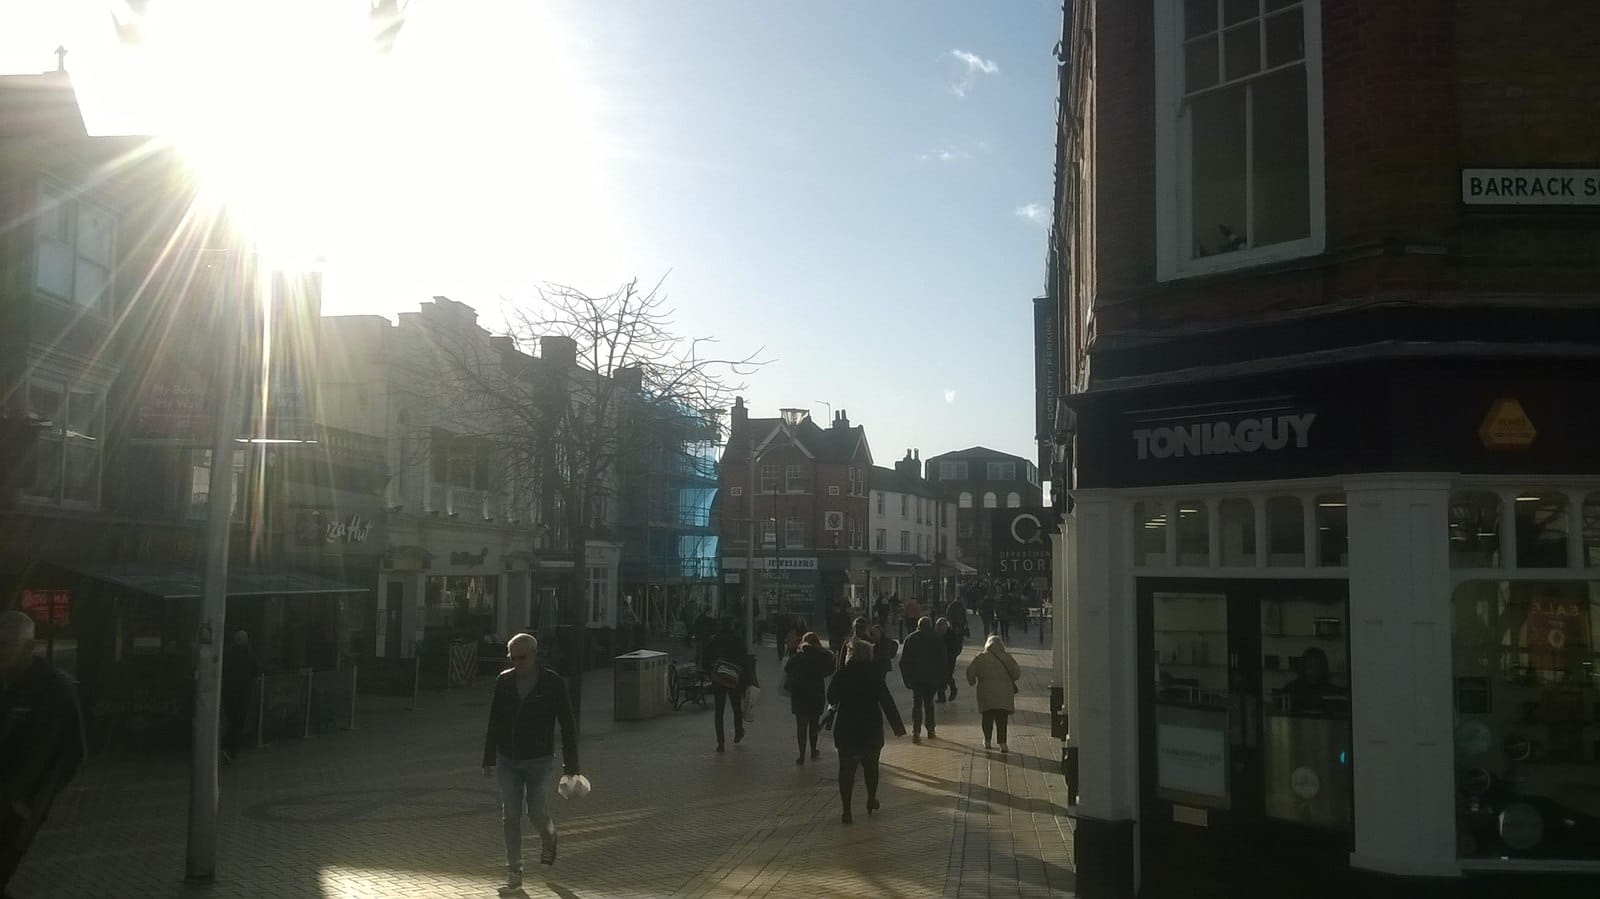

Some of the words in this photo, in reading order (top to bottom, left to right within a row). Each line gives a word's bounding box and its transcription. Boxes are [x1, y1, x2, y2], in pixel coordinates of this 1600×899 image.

[1470, 177, 1575, 196] BARRACK
[1583, 178, 1600, 196] S
[1132, 412, 1318, 461] TONI&GUY
[999, 551, 1050, 559] DEPARTMEN
[768, 559, 814, 567] JEWELLERS
[1000, 559, 1046, 572] STOR
